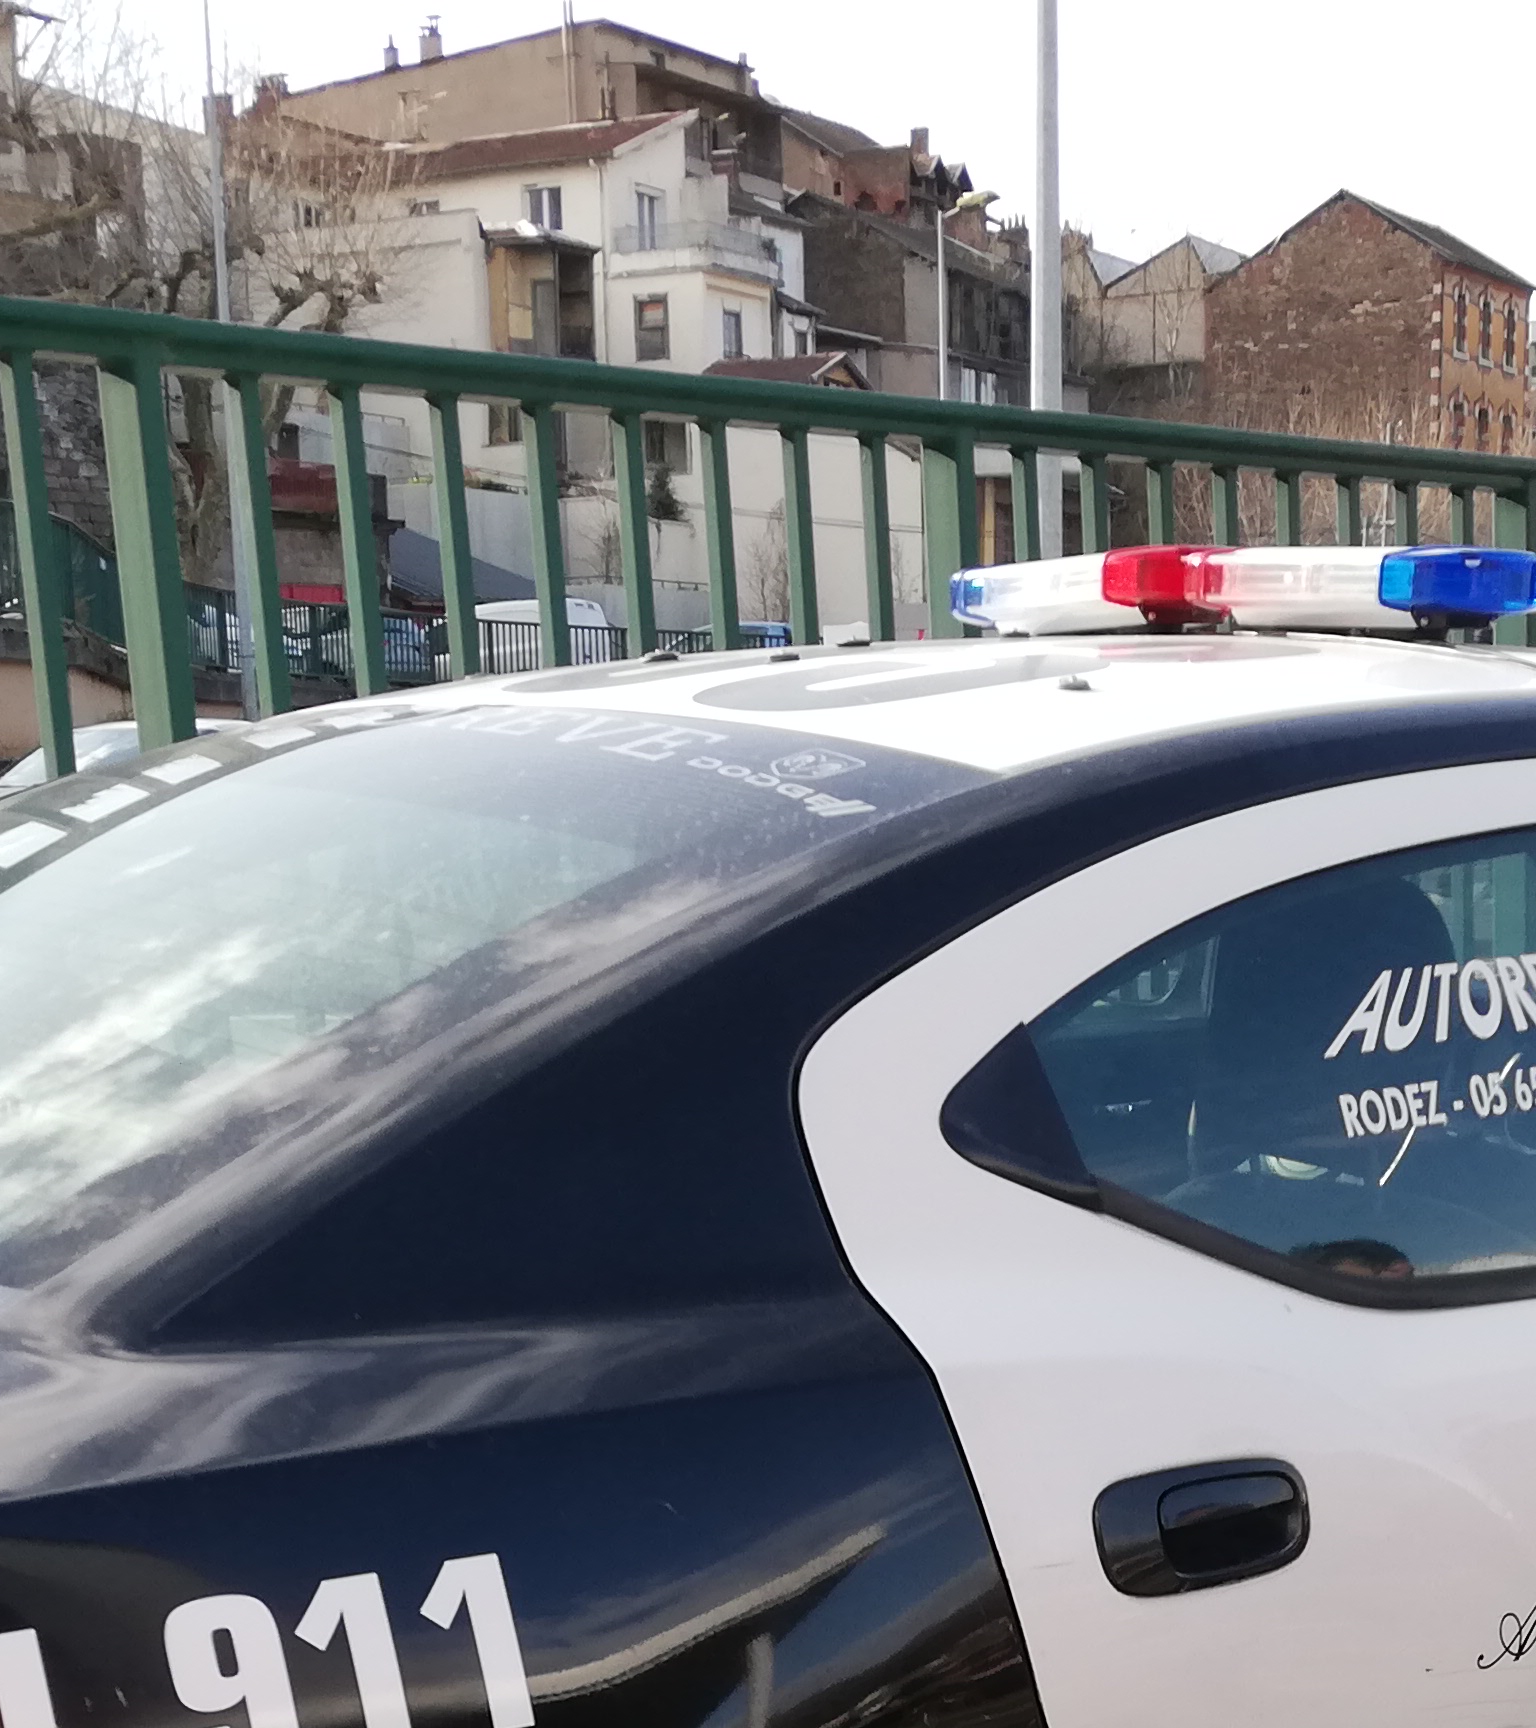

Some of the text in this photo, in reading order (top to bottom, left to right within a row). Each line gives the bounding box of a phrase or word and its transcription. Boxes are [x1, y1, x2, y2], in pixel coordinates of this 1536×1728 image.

[686, 755, 876, 818] DODGE
[1338, 1080, 1448, 1138] RODEZ
[1469, 1072, 1508, 1118] 05
